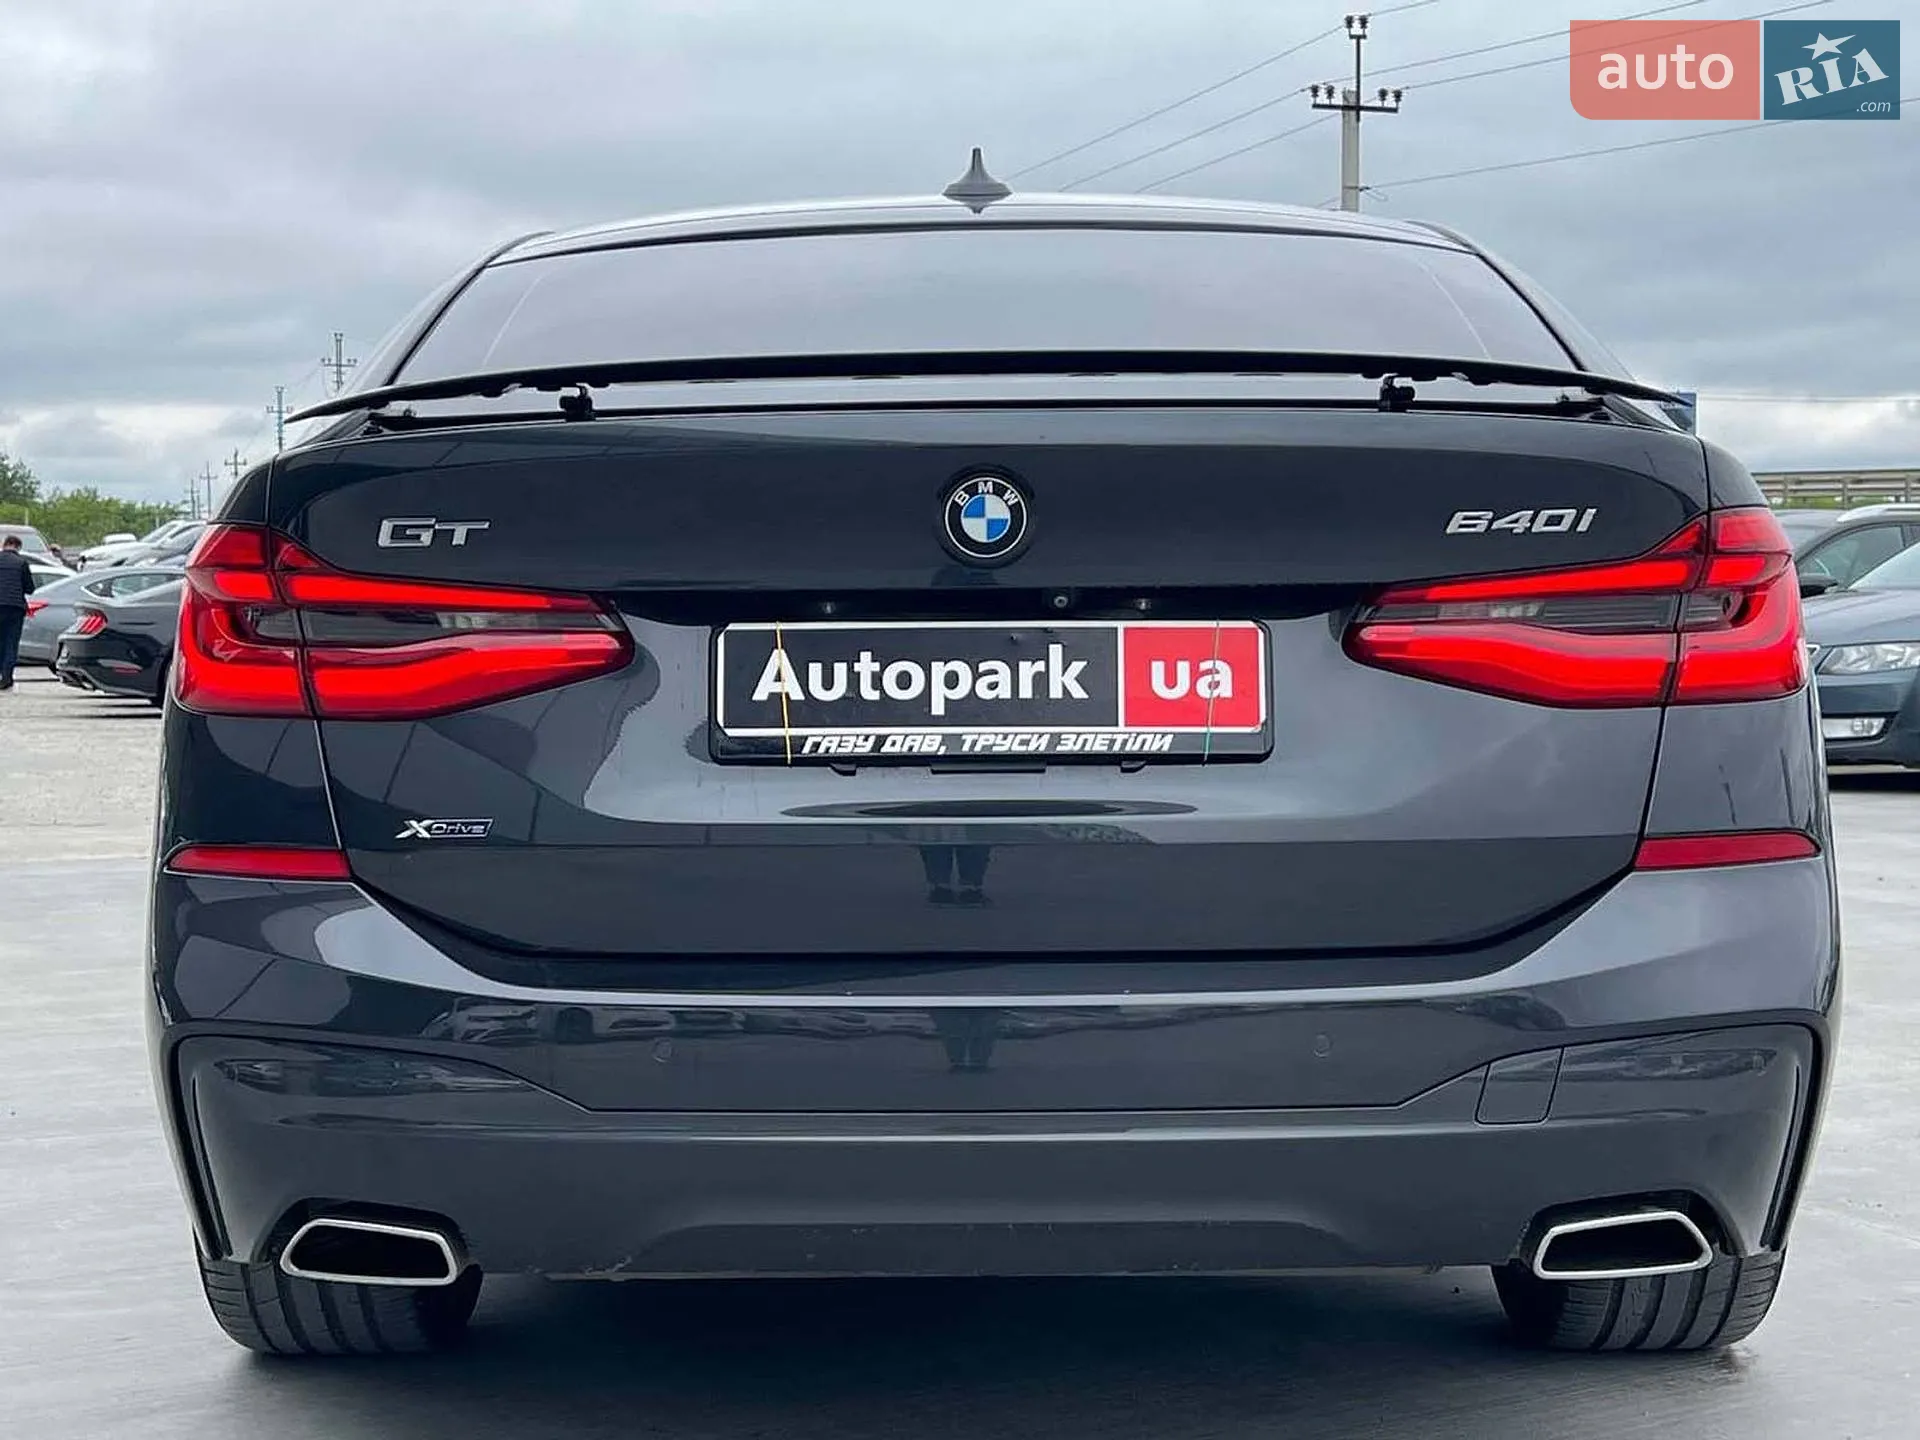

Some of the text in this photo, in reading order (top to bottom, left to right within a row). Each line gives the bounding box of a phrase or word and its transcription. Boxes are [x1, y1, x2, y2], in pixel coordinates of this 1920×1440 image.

[954, 481, 1019, 507] BMW
[378, 517, 490, 547] GT
[752, 644, 1233, 716] Autopark ua
[801, 733, 876, 754] ГАЗУ
[961, 733, 1051, 752] ТРУСИ
